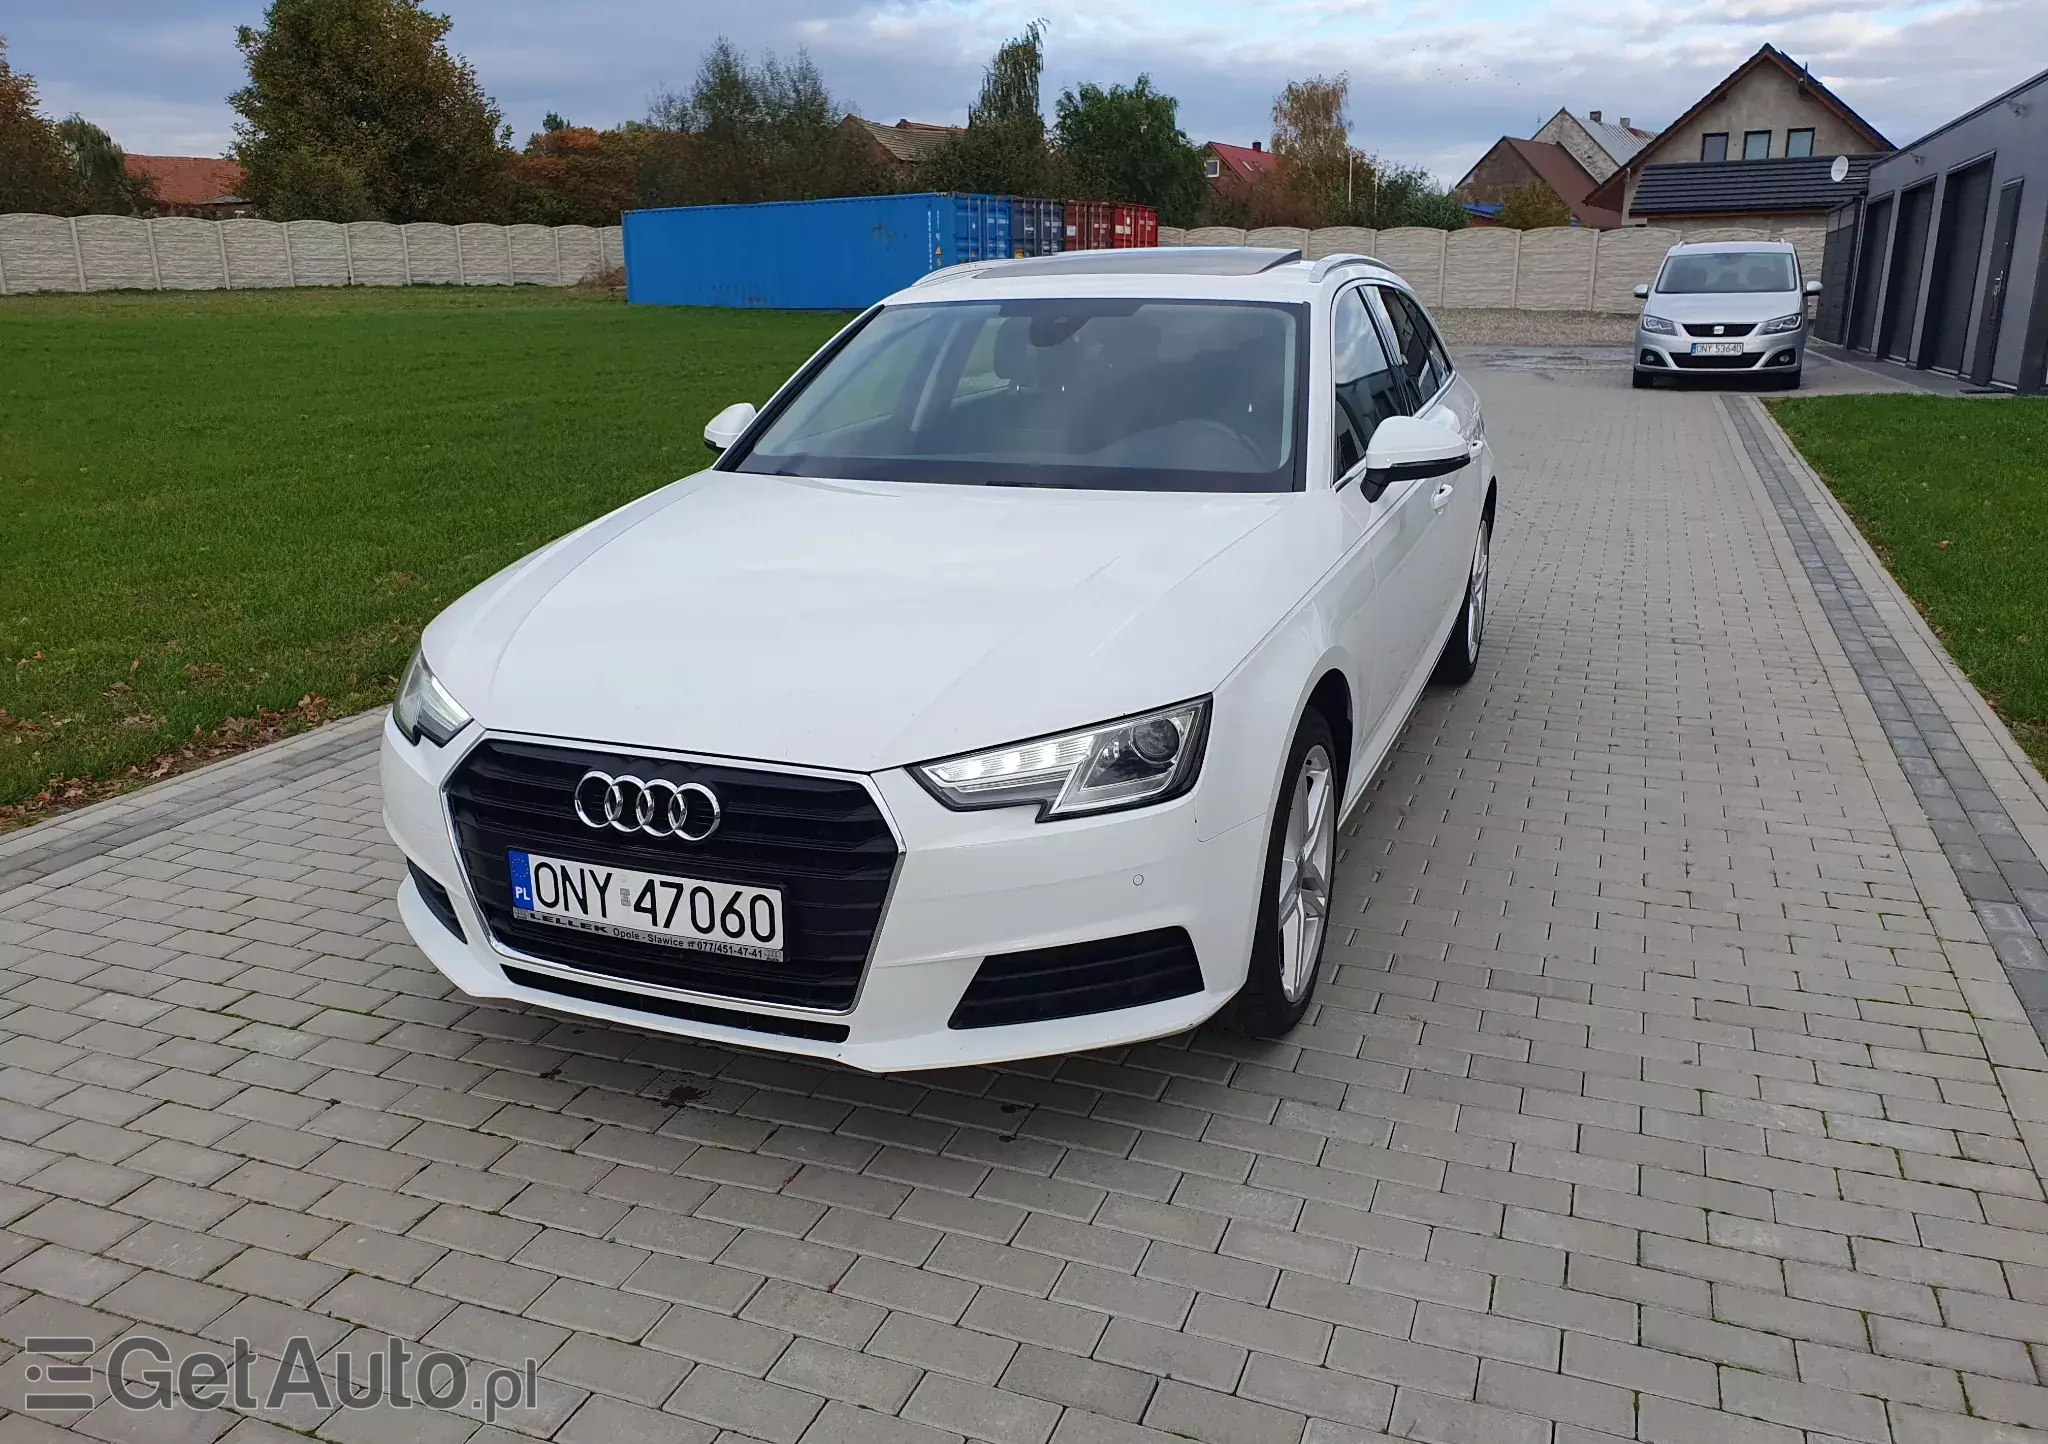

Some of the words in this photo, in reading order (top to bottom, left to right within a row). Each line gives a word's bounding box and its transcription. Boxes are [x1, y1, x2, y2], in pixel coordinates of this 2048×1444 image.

[1696, 344, 1712, 353] ONY
[1715, 344, 1742, 353] 53640
[515, 886, 531, 901] PL
[534, 861, 613, 919] ONY
[633, 878, 776, 943] 47060
[529, 912, 608, 934] LELLEK
[613, 927, 640, 940] Opole
[697, 941, 762, 958] 077/451-47-41
